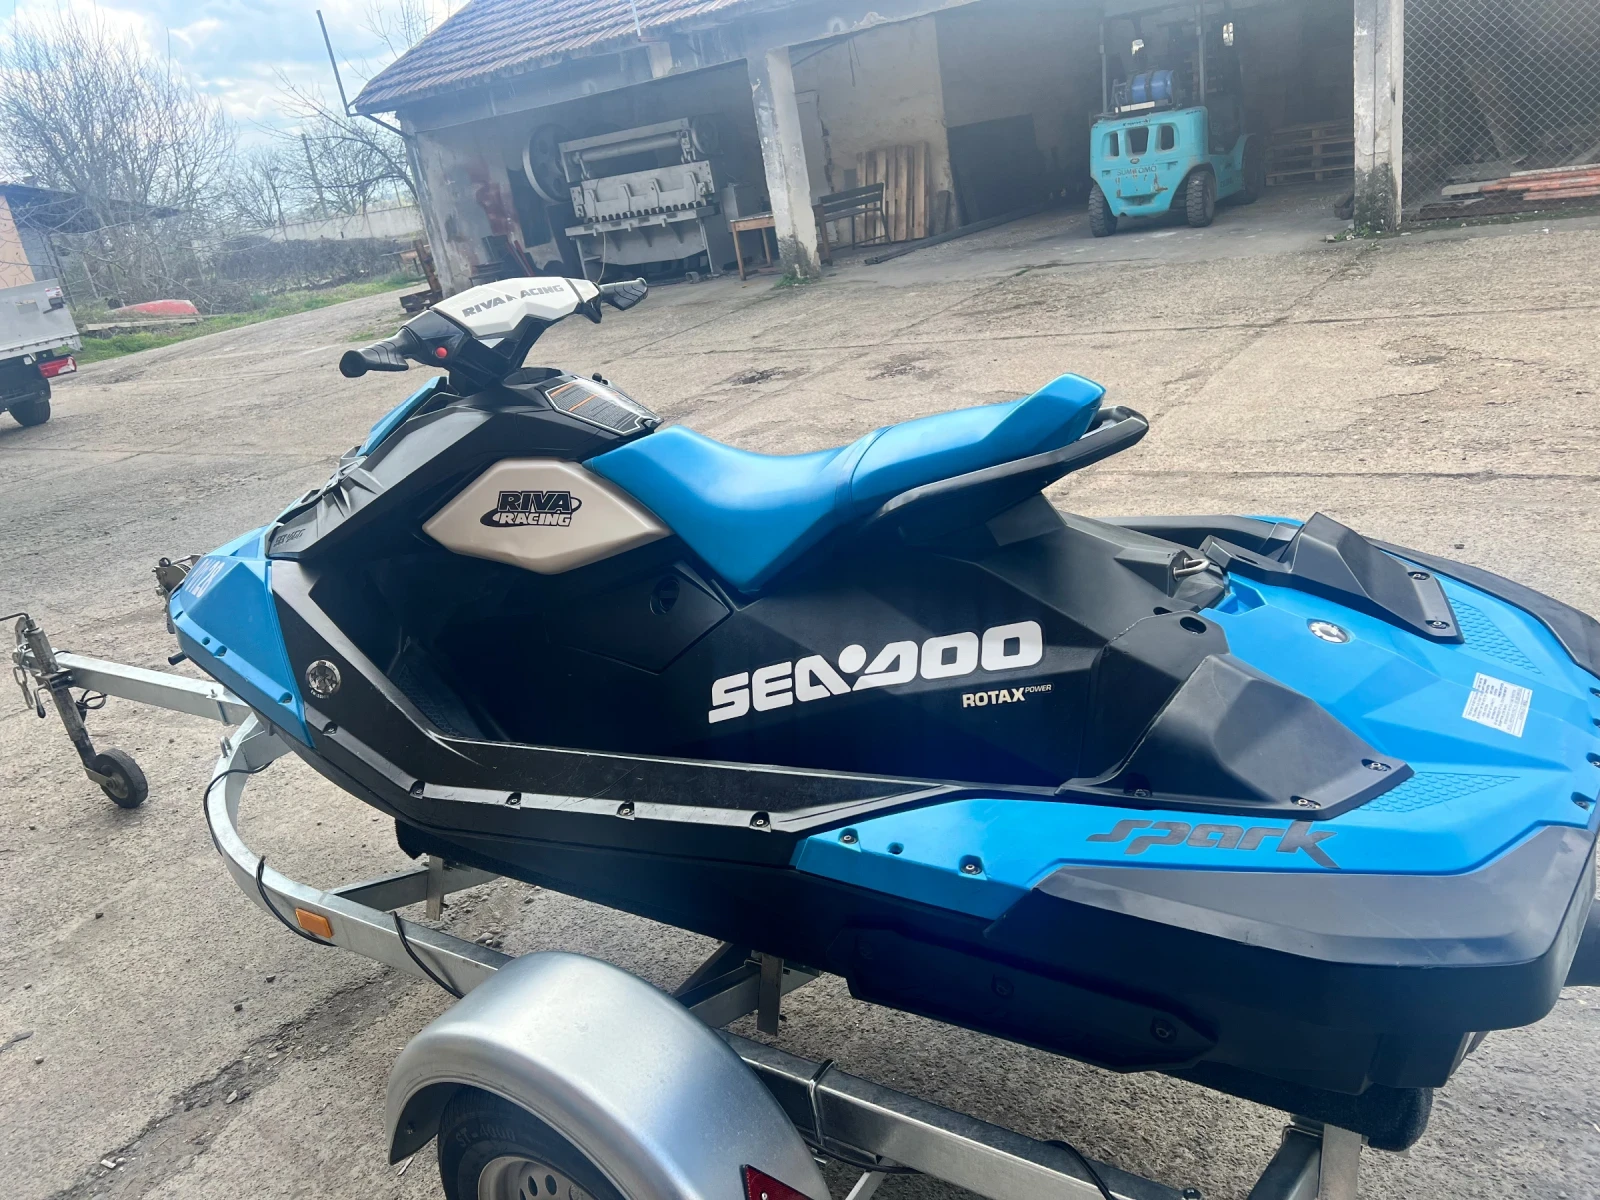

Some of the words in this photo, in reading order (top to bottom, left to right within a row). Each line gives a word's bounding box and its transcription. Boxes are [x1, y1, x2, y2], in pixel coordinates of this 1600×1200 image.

[461, 296, 506, 317] RIVA
[498, 491, 572, 513] RIVA
[499, 512, 571, 526] RACING
[962, 687, 1025, 708] ROTAX
[1024, 684, 1052, 693] POWER
